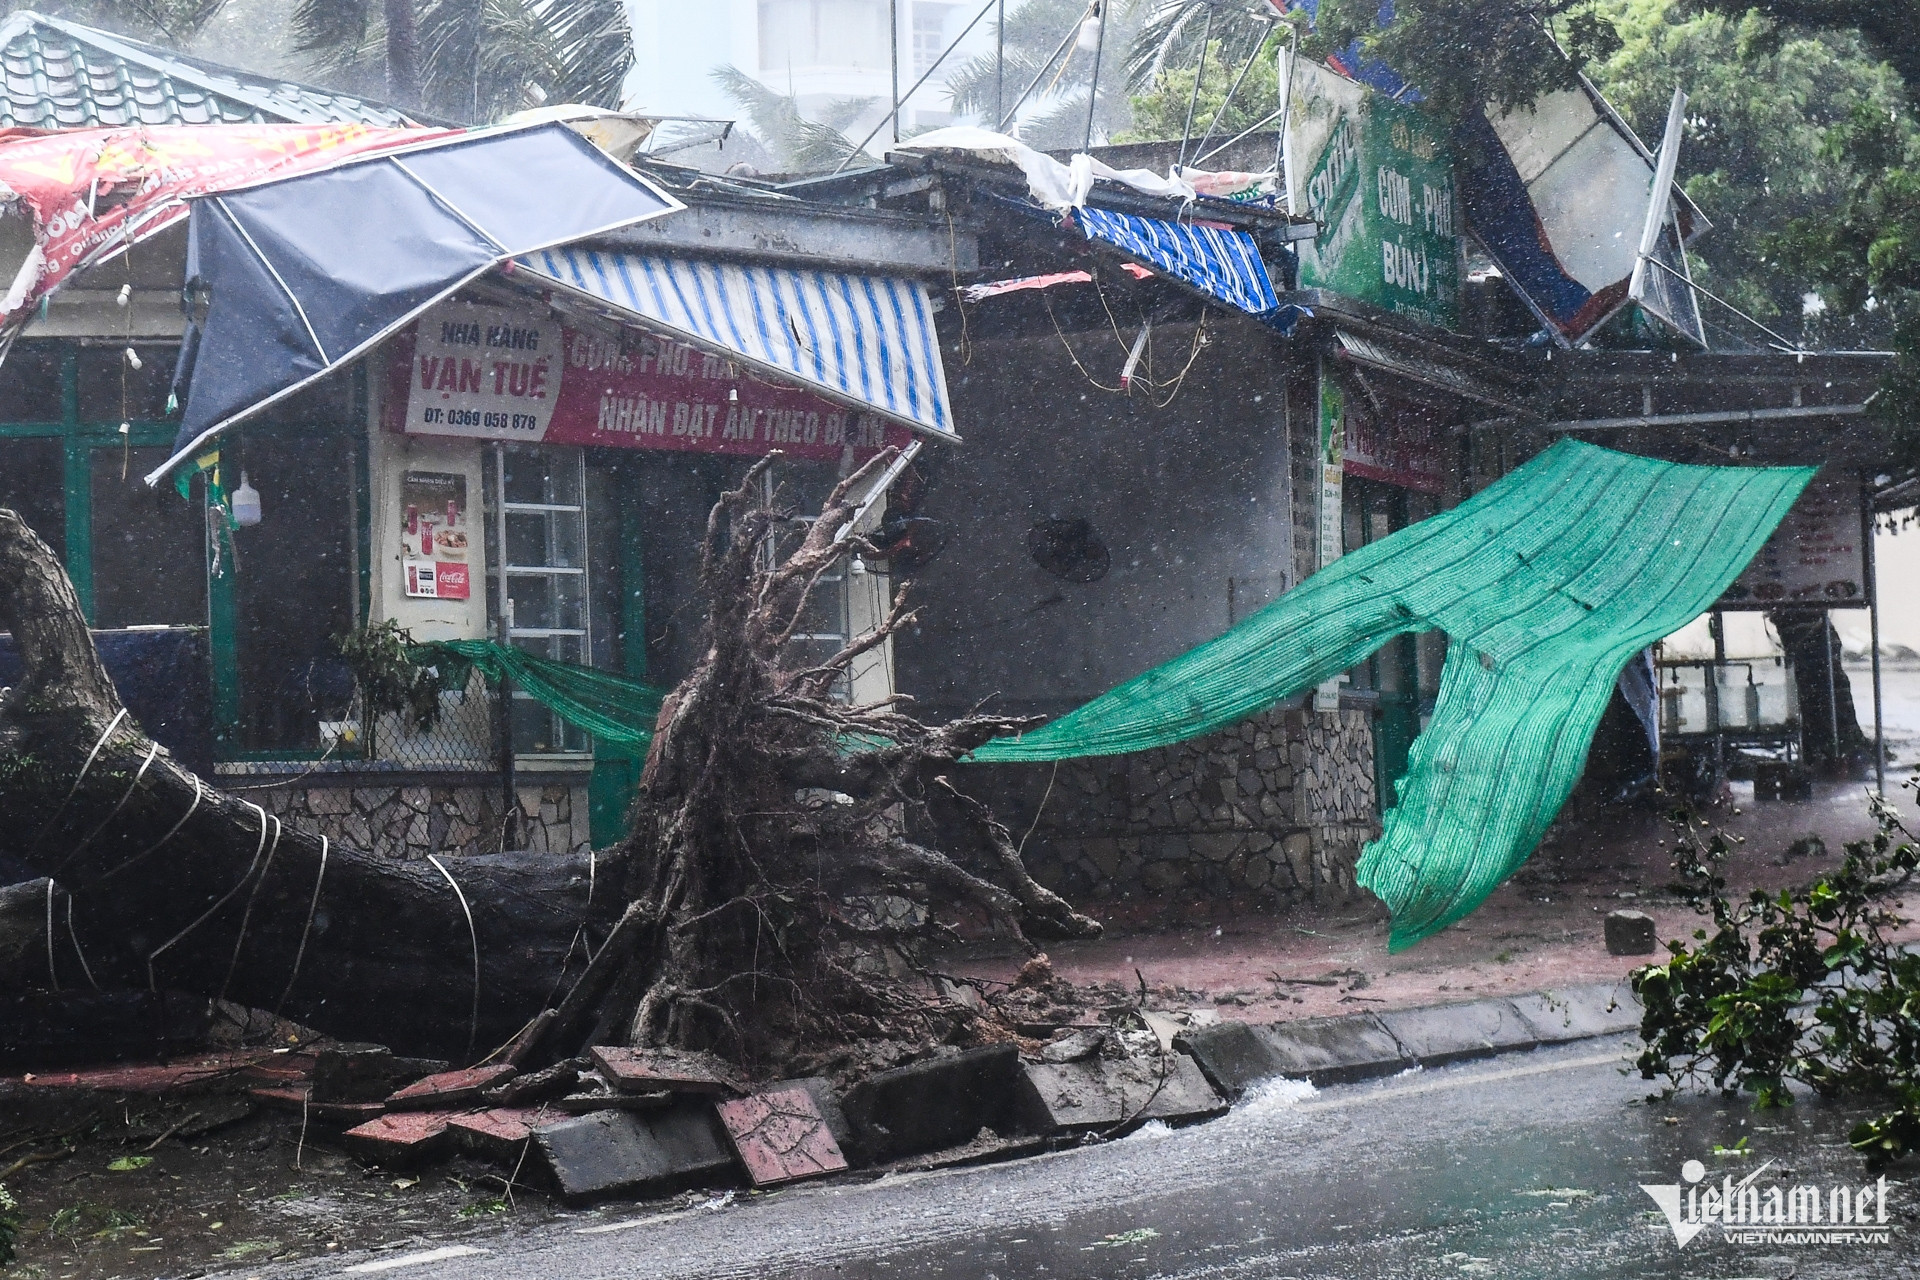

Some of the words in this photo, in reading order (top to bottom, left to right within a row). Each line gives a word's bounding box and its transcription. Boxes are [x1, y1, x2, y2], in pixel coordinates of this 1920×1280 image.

[441, 320, 480, 346] NHÀ
[486, 323, 540, 350] HÀNG
[420, 355, 482, 399] VẠN
[493, 354, 552, 399] TUẾ
[424, 407, 444, 424] ĐT:
[447, 409, 481, 427] 0369
[484, 412, 509, 429] 058
[512, 414, 537, 430] 878
[598, 392, 667, 440] NHẬN
[671, 397, 719, 444] ĐẶT
[763, 407, 819, 443] THEO
